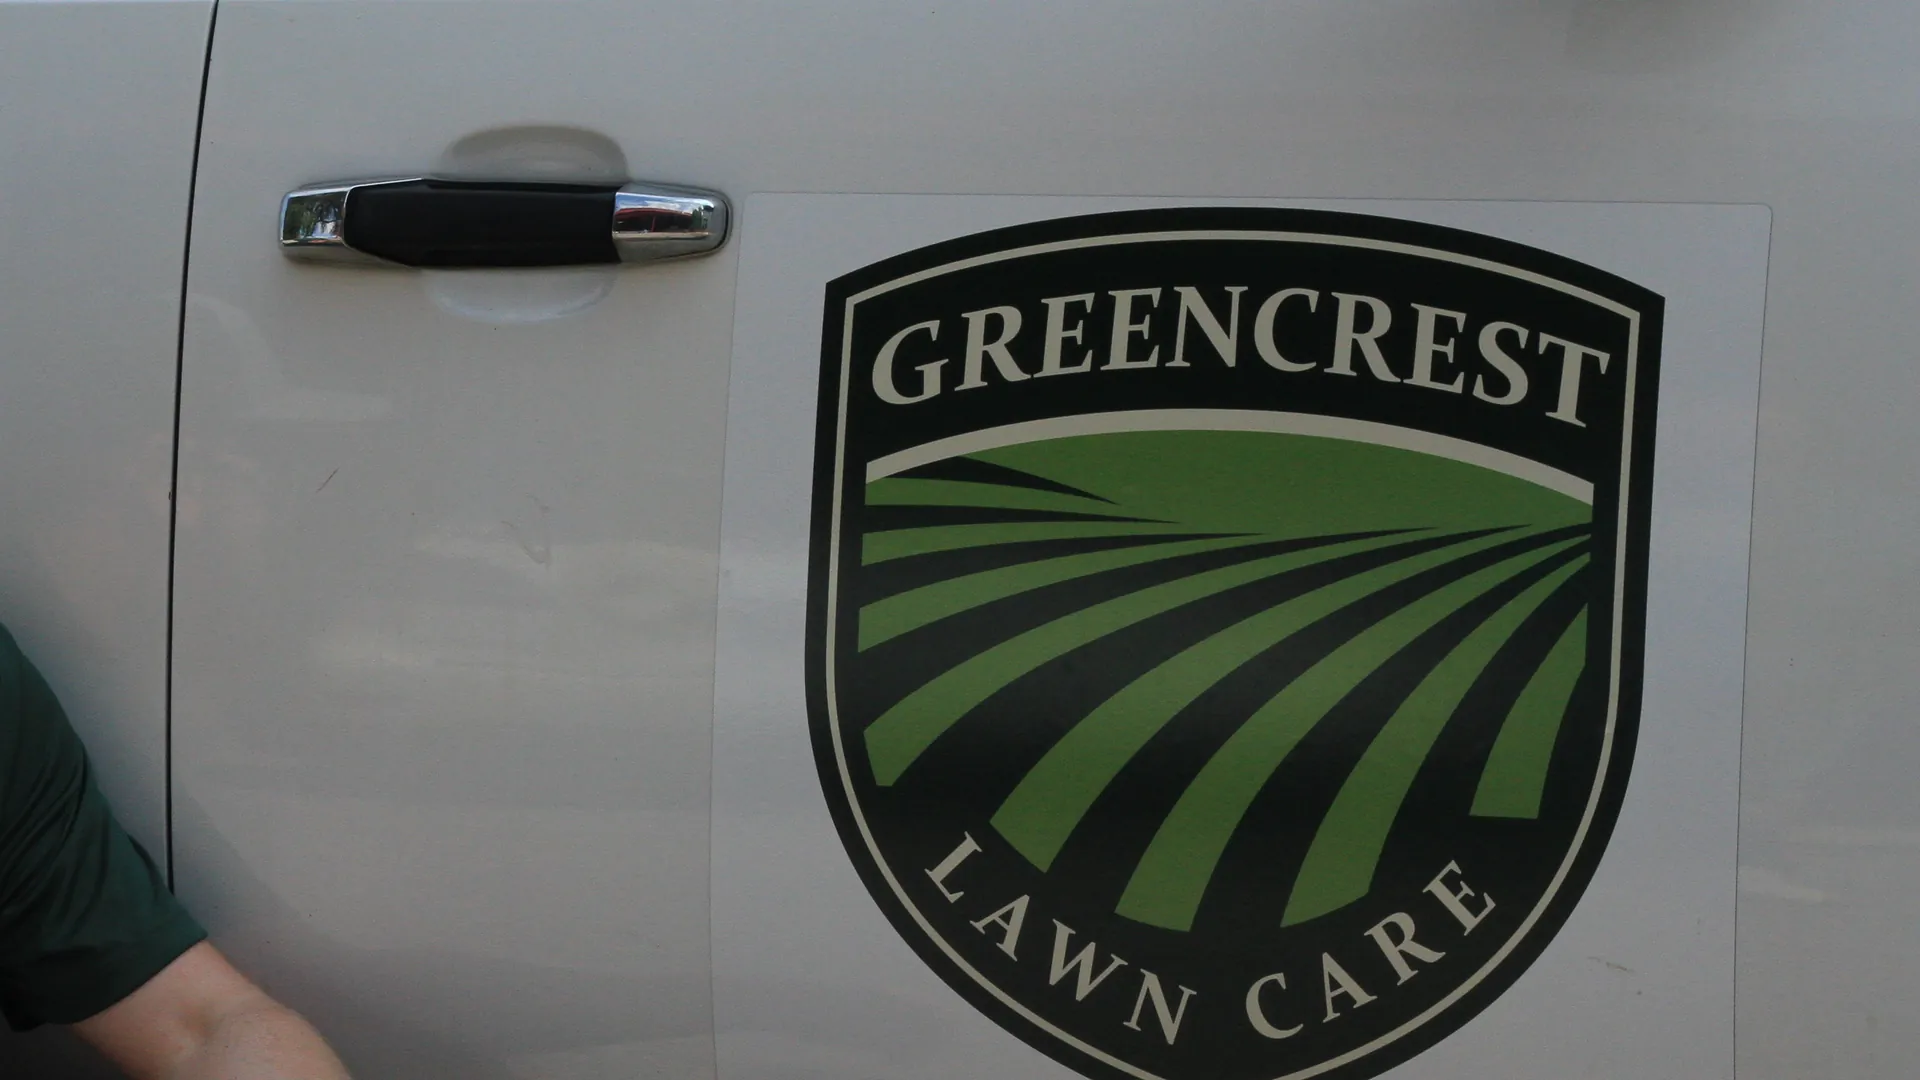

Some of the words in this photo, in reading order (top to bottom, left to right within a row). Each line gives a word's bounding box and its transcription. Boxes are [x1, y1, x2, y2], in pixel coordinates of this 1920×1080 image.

[871, 285, 1611, 428] GREENCREST
[924, 831, 1197, 1045] LAWN
[1245, 859, 1496, 1040] CARE
